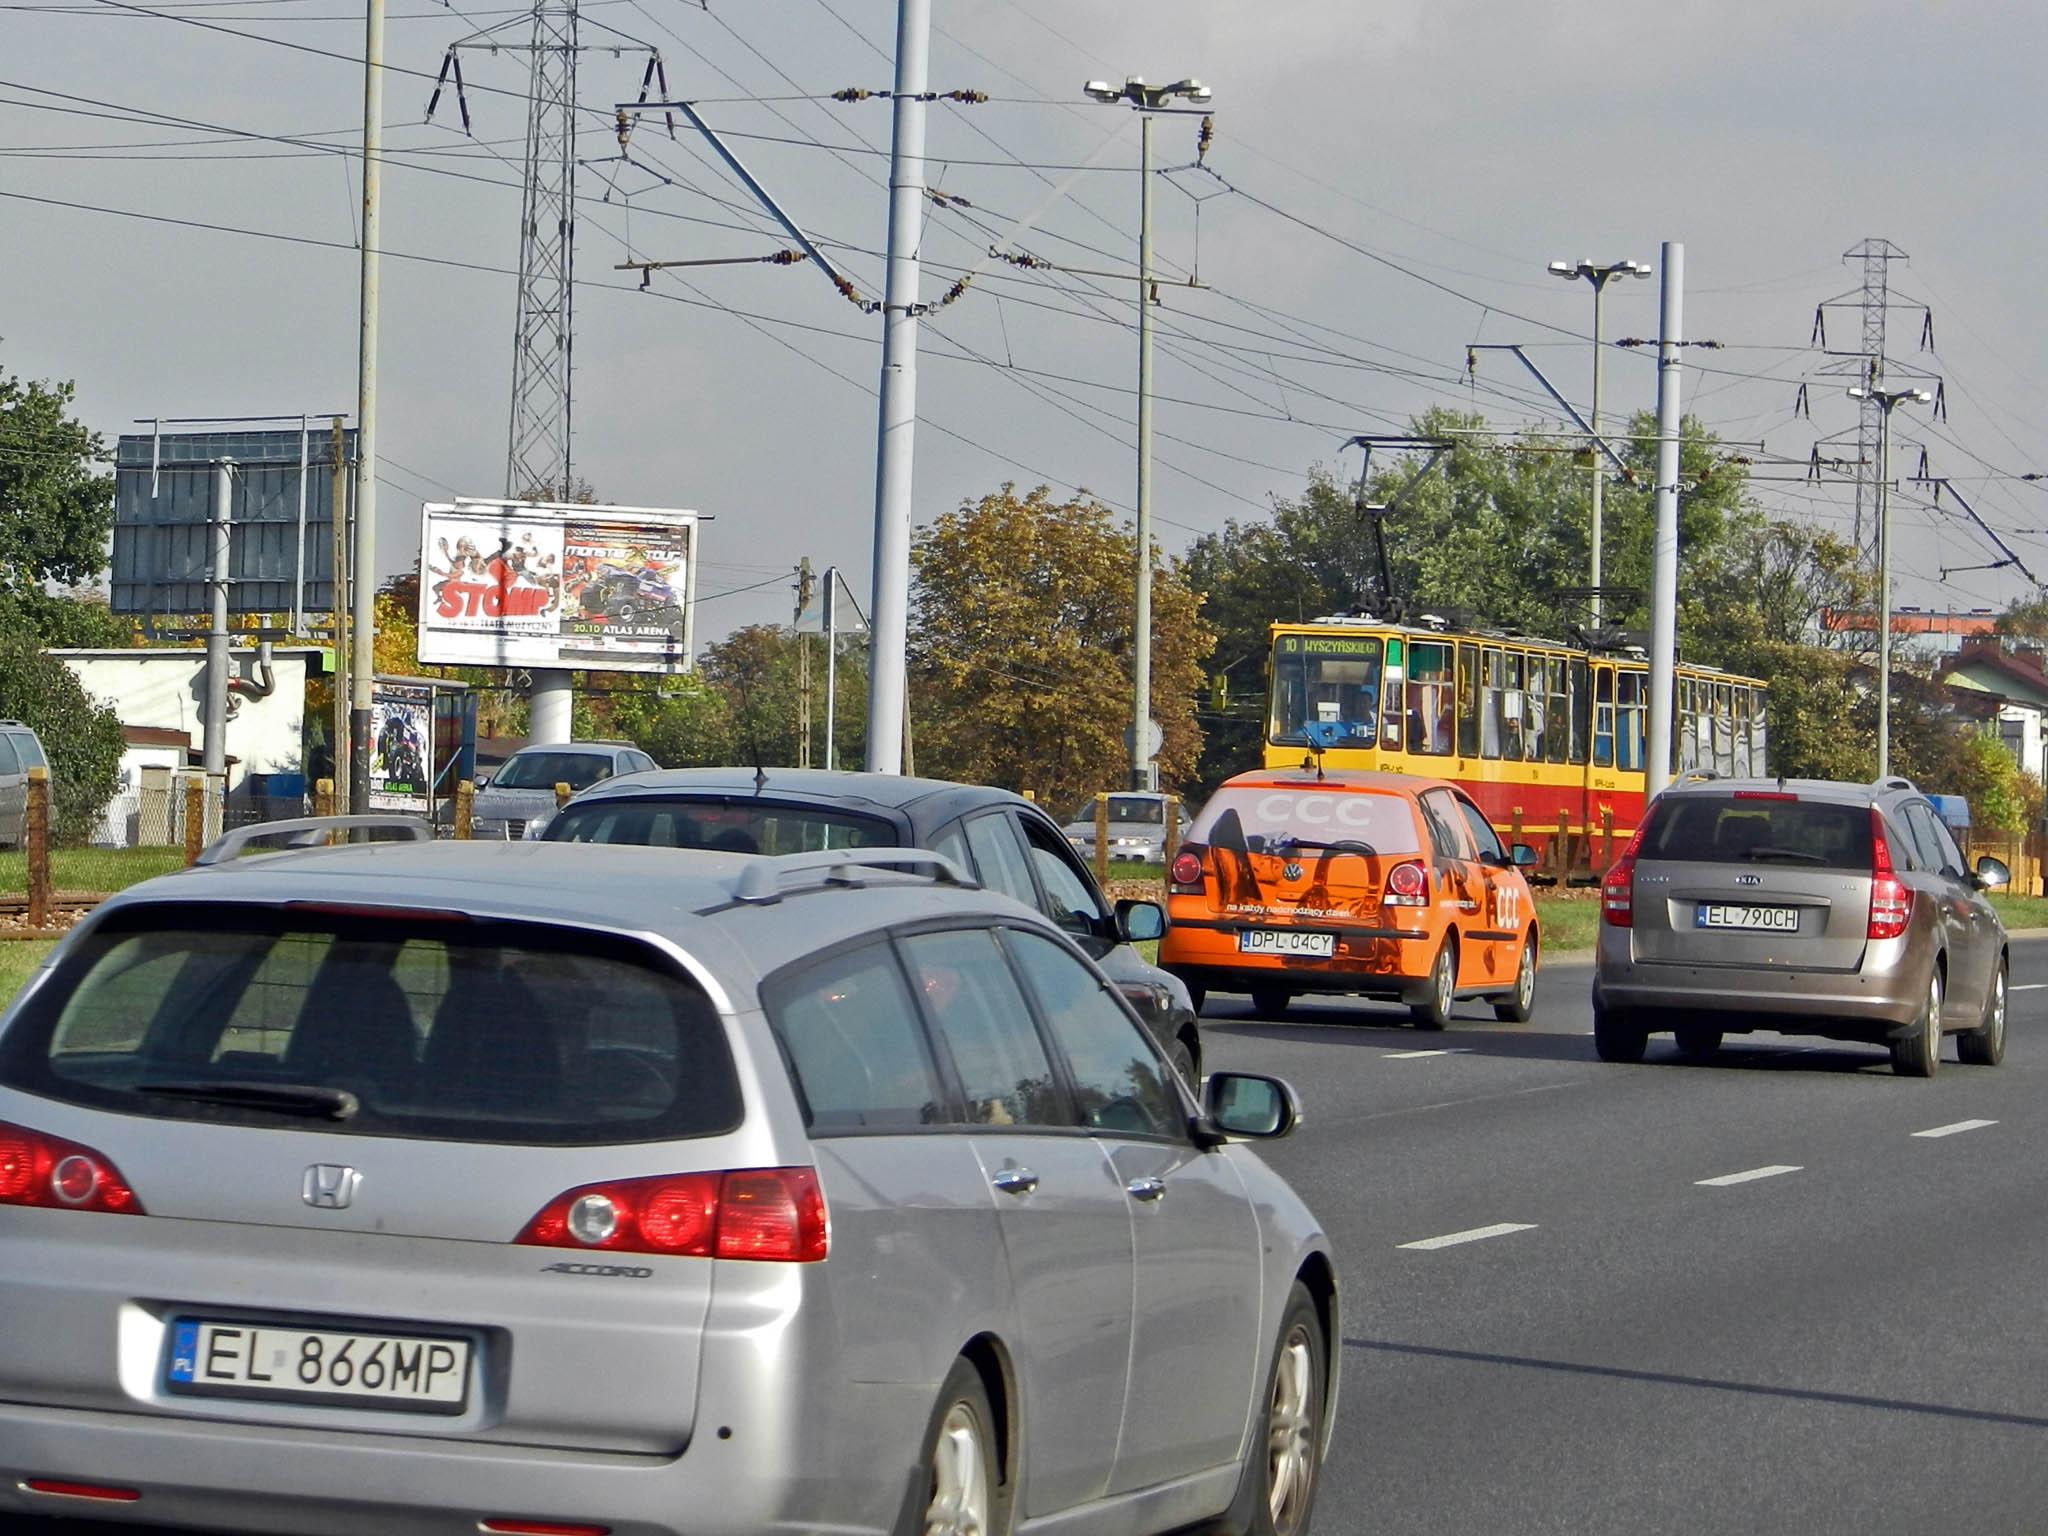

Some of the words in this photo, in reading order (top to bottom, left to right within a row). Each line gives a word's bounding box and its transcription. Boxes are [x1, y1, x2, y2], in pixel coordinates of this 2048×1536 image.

[437, 581, 549, 618] STOMP
[573, 624, 600, 633] 20.10
[603, 625, 633, 635] ATLAS
[636, 626, 671, 636] ARENA
[1285, 639, 1297, 652] 10
[1256, 794, 1374, 826] CCC
[1497, 887, 1519, 929] CCC
[1709, 906, 1733, 924] EL
[1740, 908, 1796, 928] 790CH
[1252, 931, 1284, 949] DPL
[1291, 934, 1331, 951] 04CY
[539, 1262, 653, 1278] ACCORD
[173, 1358, 194, 1372] PL
[206, 1328, 272, 1381] EL
[298, 1335, 457, 1394] 866MP
